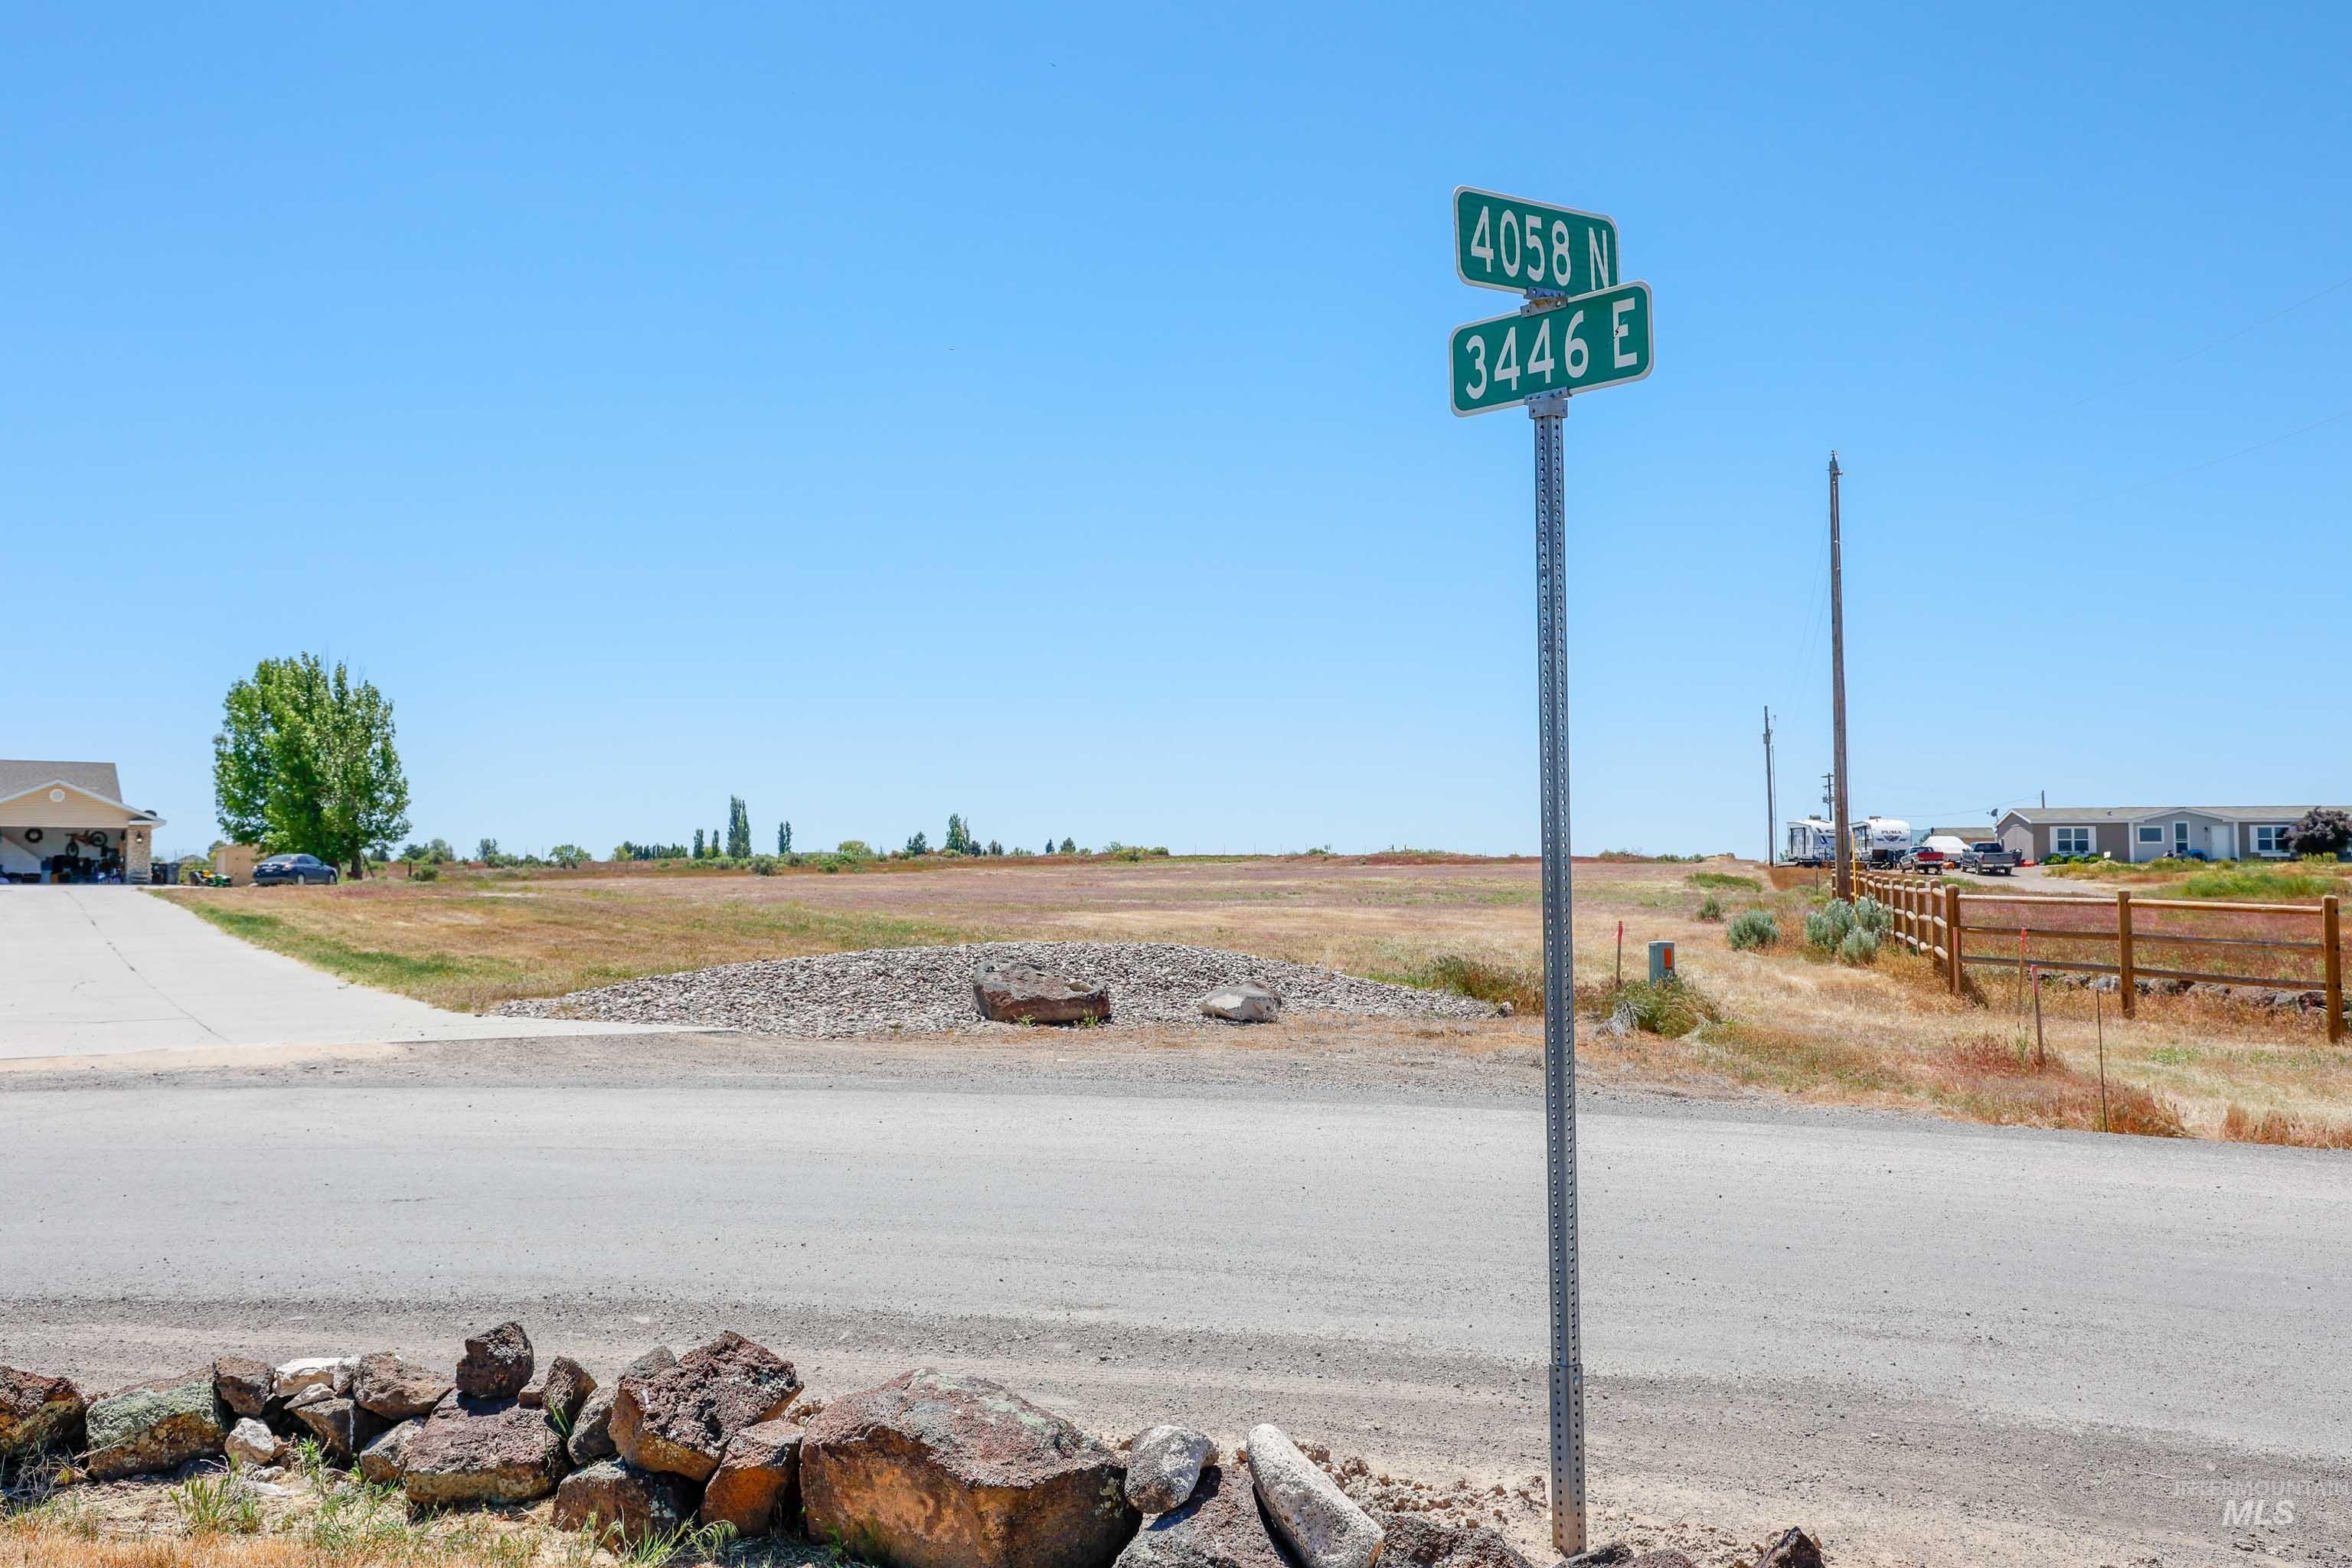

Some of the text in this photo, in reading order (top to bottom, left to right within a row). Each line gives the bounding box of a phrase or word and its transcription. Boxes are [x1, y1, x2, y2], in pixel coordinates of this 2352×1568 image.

[1470, 205, 1610, 291] 4058 N
[1465, 297, 1638, 400] 3446 E
